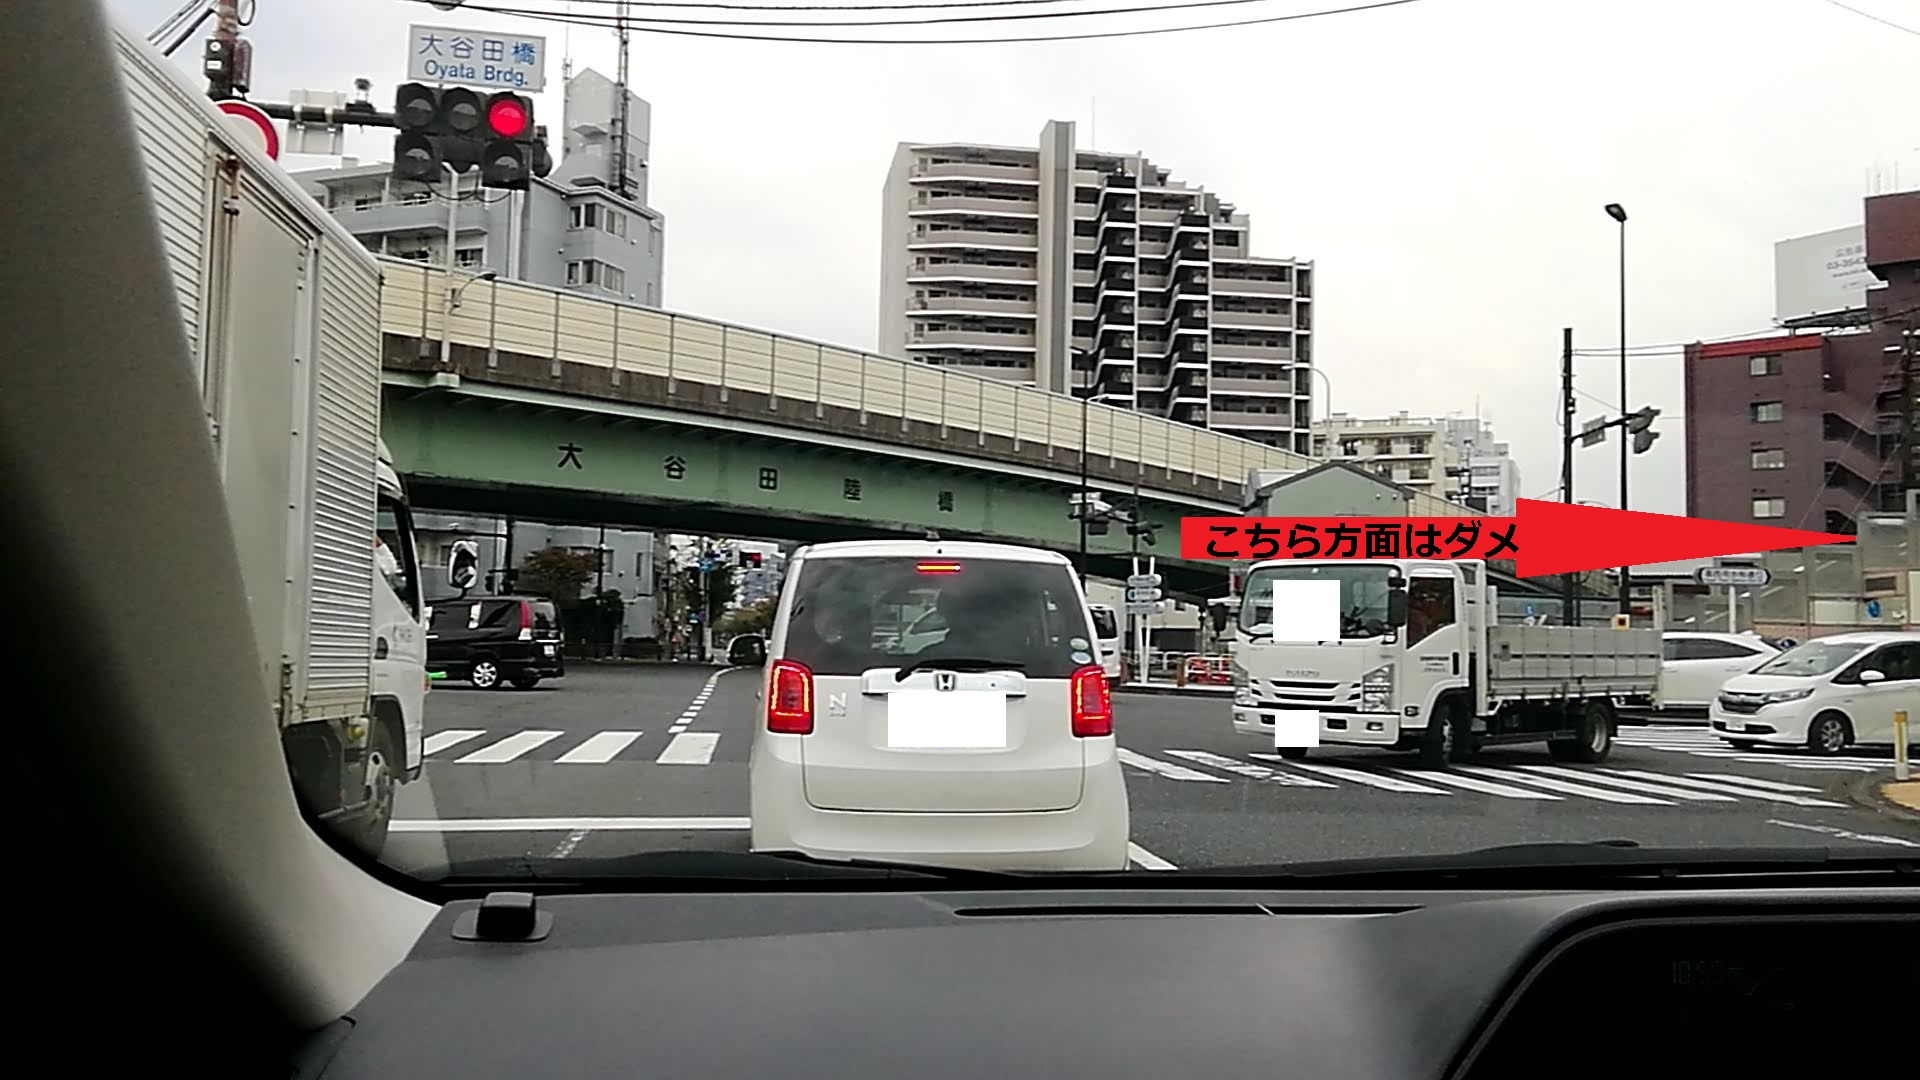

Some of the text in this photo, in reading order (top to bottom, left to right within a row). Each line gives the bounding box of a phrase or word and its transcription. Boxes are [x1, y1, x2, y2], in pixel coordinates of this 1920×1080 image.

[418, 33, 536, 65] 大谷田橋
[424, 59, 528, 87] Oyata Brdg.
[556, 442, 954, 513] 大谷田陸橋
